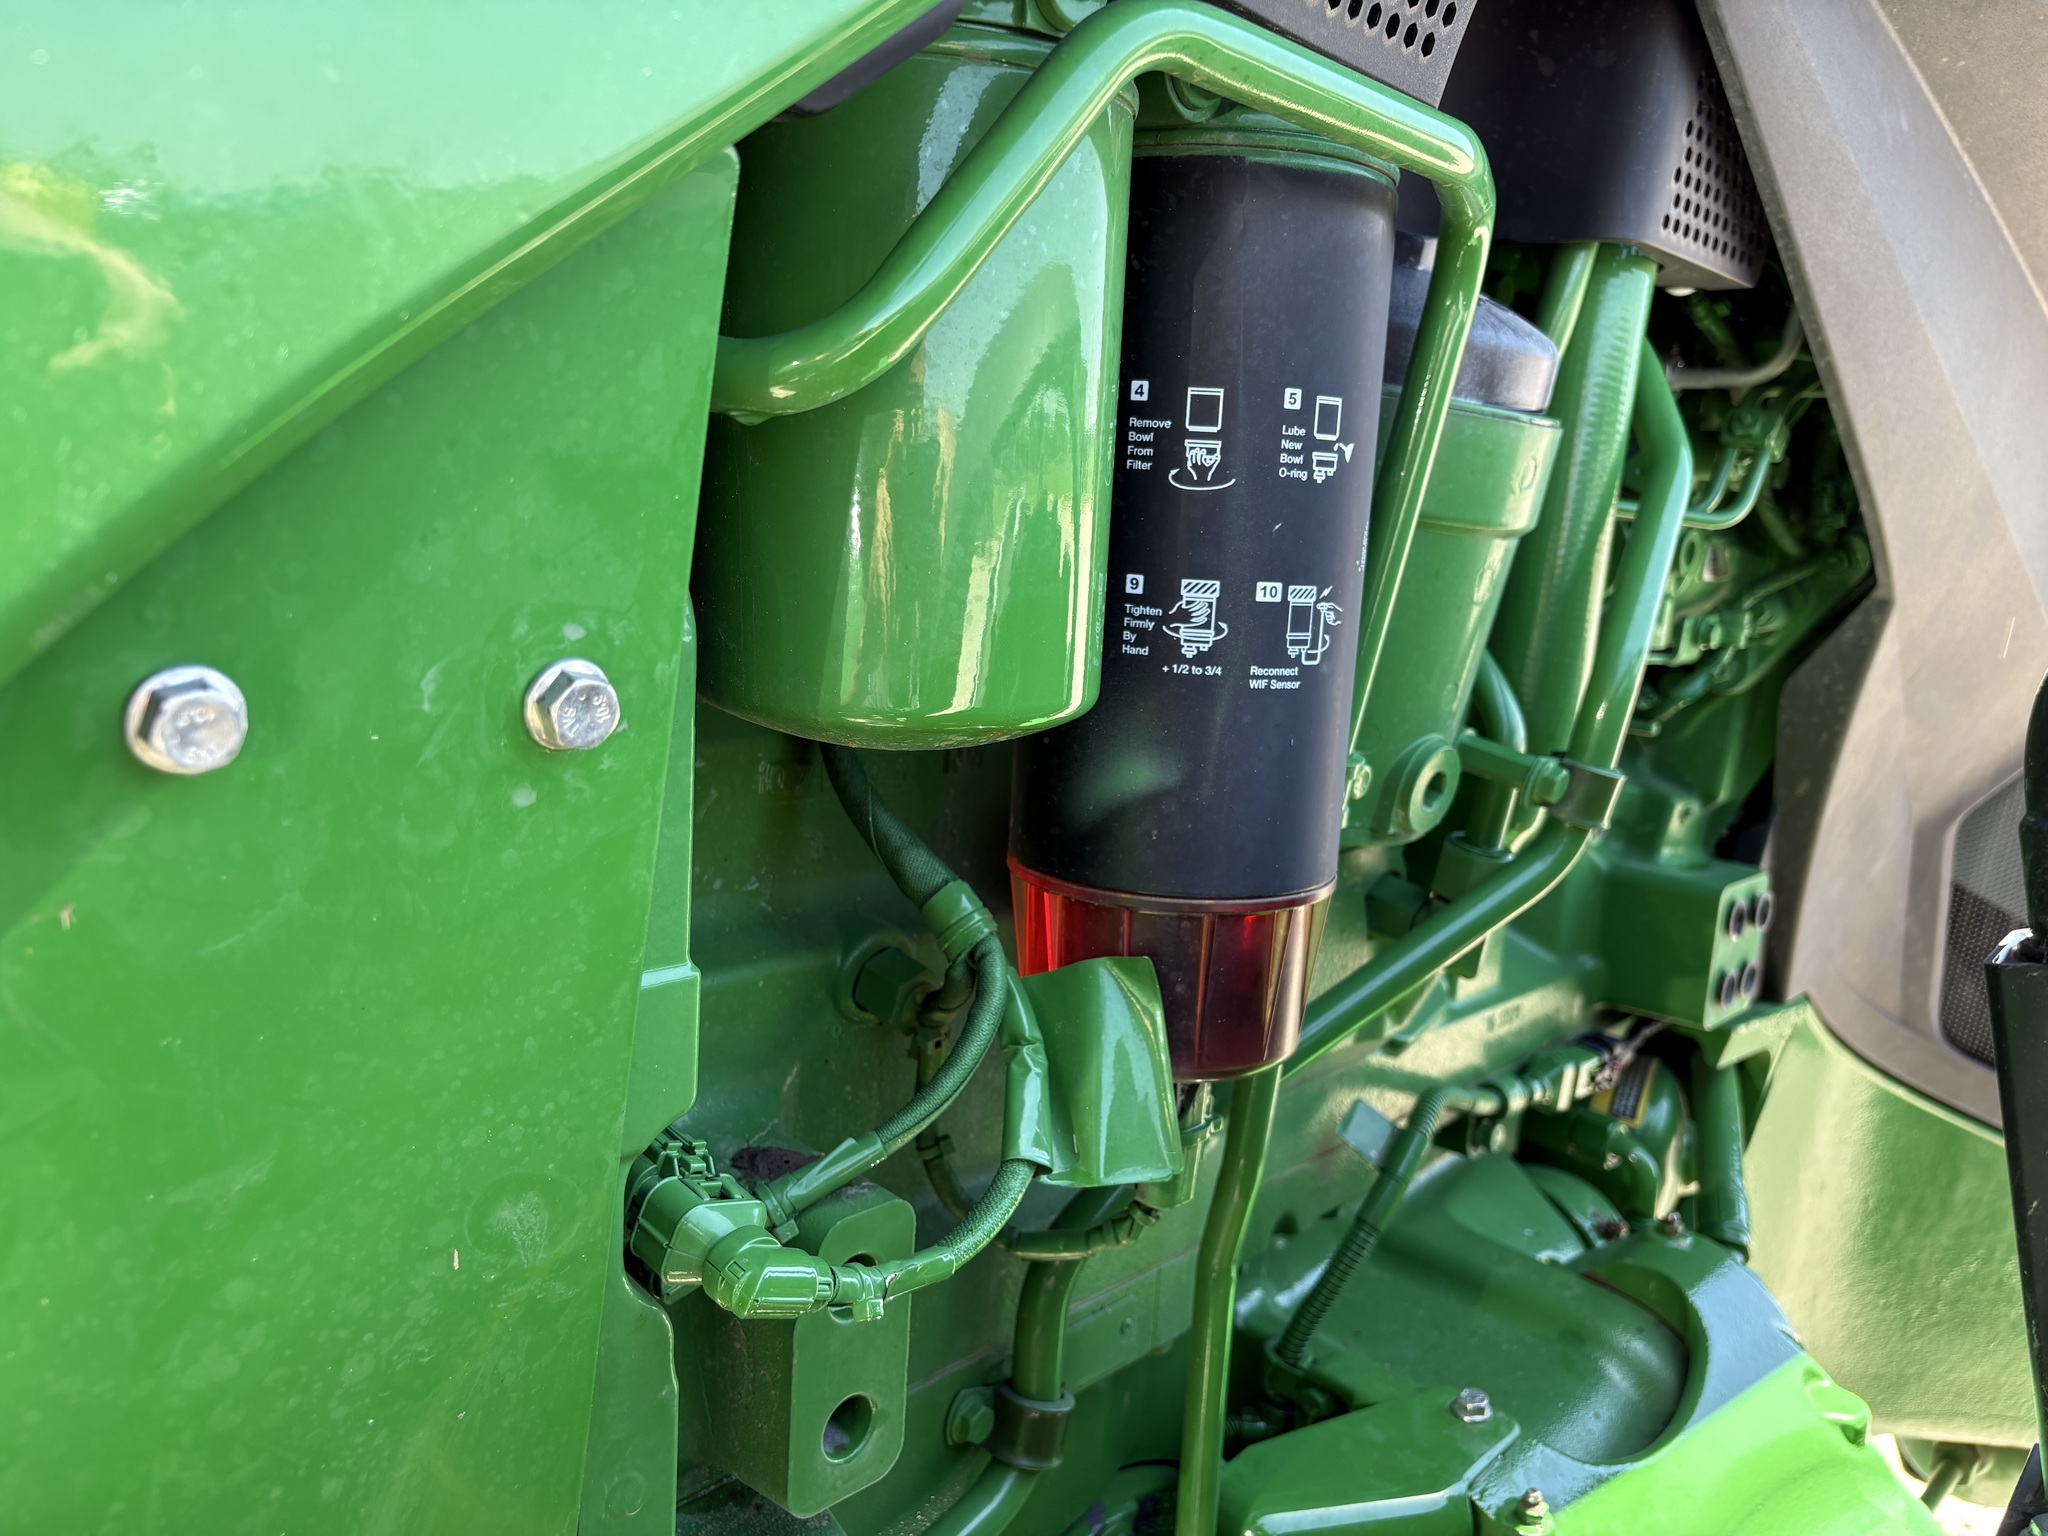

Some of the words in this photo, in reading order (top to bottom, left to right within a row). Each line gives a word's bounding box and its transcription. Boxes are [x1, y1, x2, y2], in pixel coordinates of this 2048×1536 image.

[1134, 383, 1144, 397] 4
[1288, 392, 1297, 405] 5
[1129, 417, 1172, 429] Remove
[1128, 431, 1154, 442] Bowl
[1282, 425, 1306, 436] Lube
[1127, 445, 1154, 456] From
[1281, 439, 1303, 450] New
[1126, 459, 1153, 470] Filter
[1280, 453, 1304, 464] Bowl
[1278, 467, 1308, 481] O-ring
[1129, 577, 1139, 590] 9
[1260, 585, 1278, 598] 10
[1124, 603, 1163, 617] Tighten
[1123, 617, 1155, 631] Firmly
[1122, 631, 1137, 643] By
[1122, 644, 1149, 656] Hand
[1172, 664, 1190, 674] 1/2
[1191, 665, 1203, 675] to
[1204, 665, 1223, 676] 3/4
[1250, 666, 1299, 676] Reconnect
[1249, 679, 1269, 689] WIF
[1270, 679, 1301, 689] Sensor
